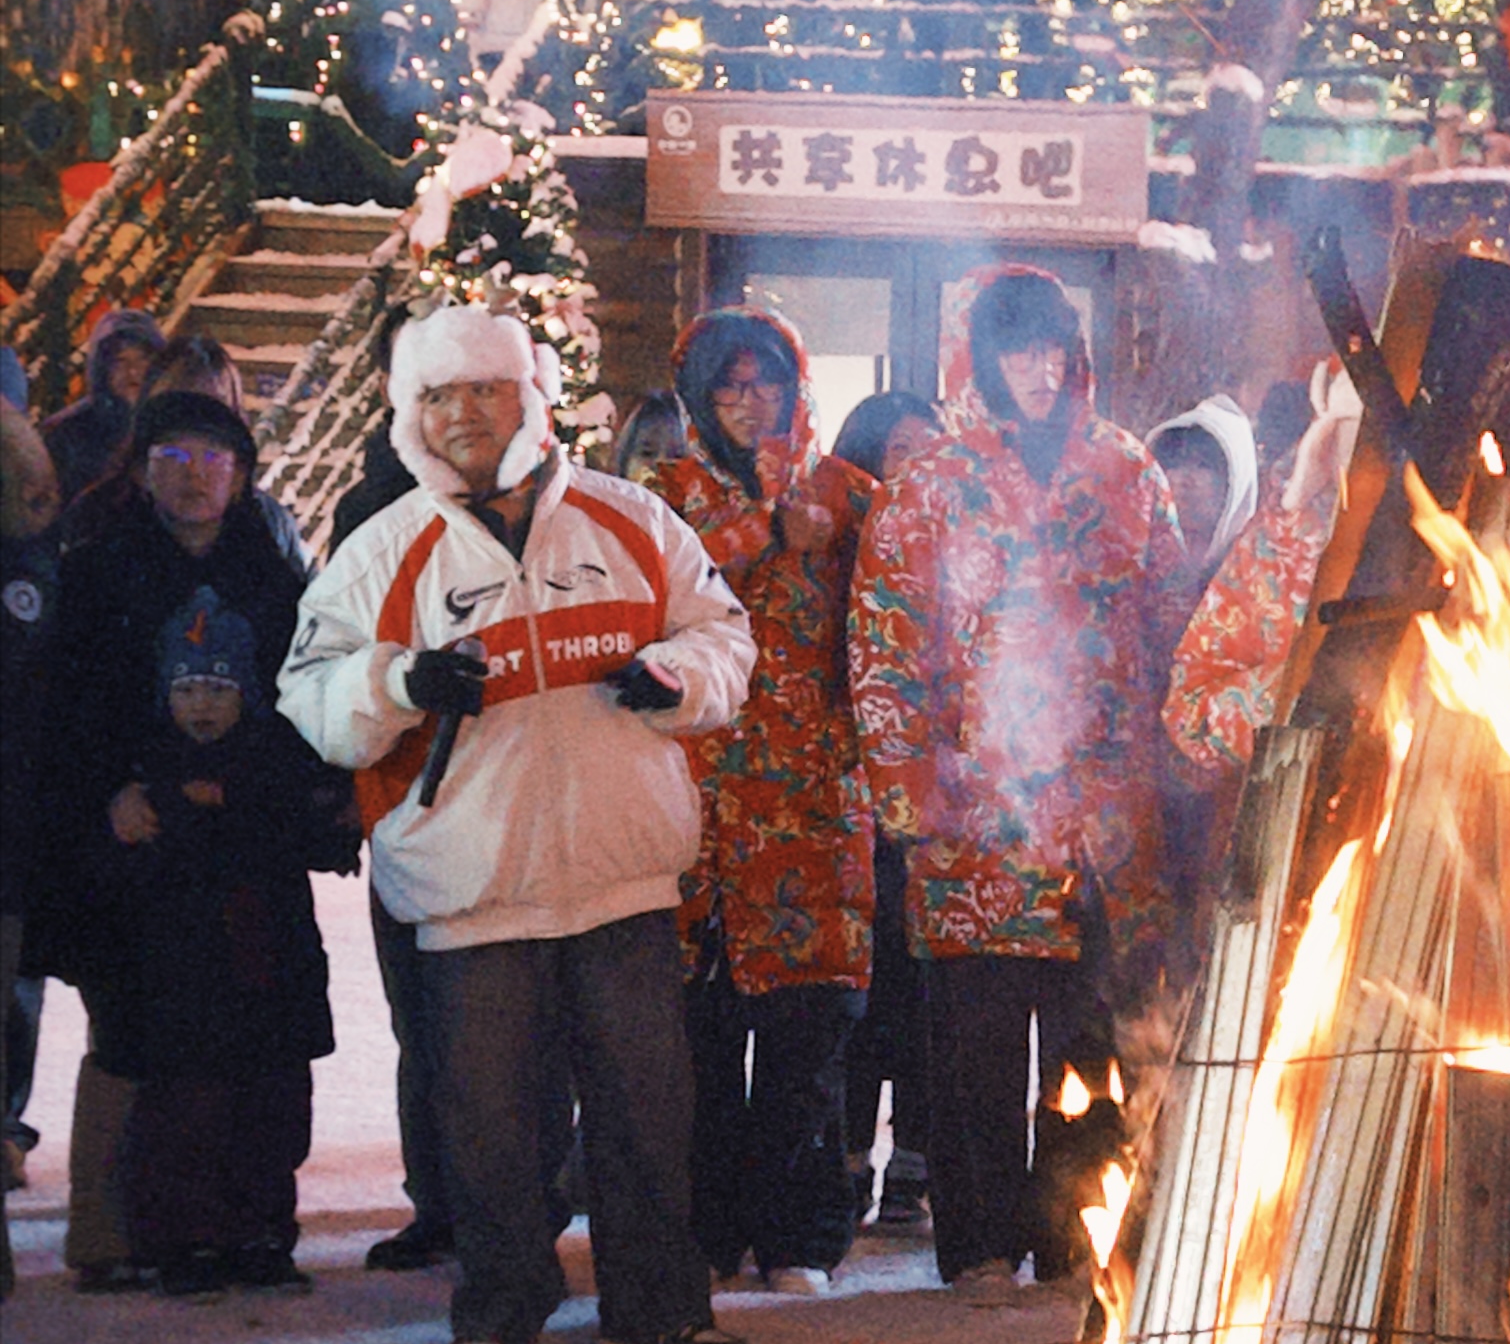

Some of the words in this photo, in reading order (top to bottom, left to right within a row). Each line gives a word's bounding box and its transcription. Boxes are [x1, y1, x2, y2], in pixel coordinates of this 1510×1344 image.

[731, 129, 1074, 199] 共享休息吧
[486, 649, 525, 678] RT
